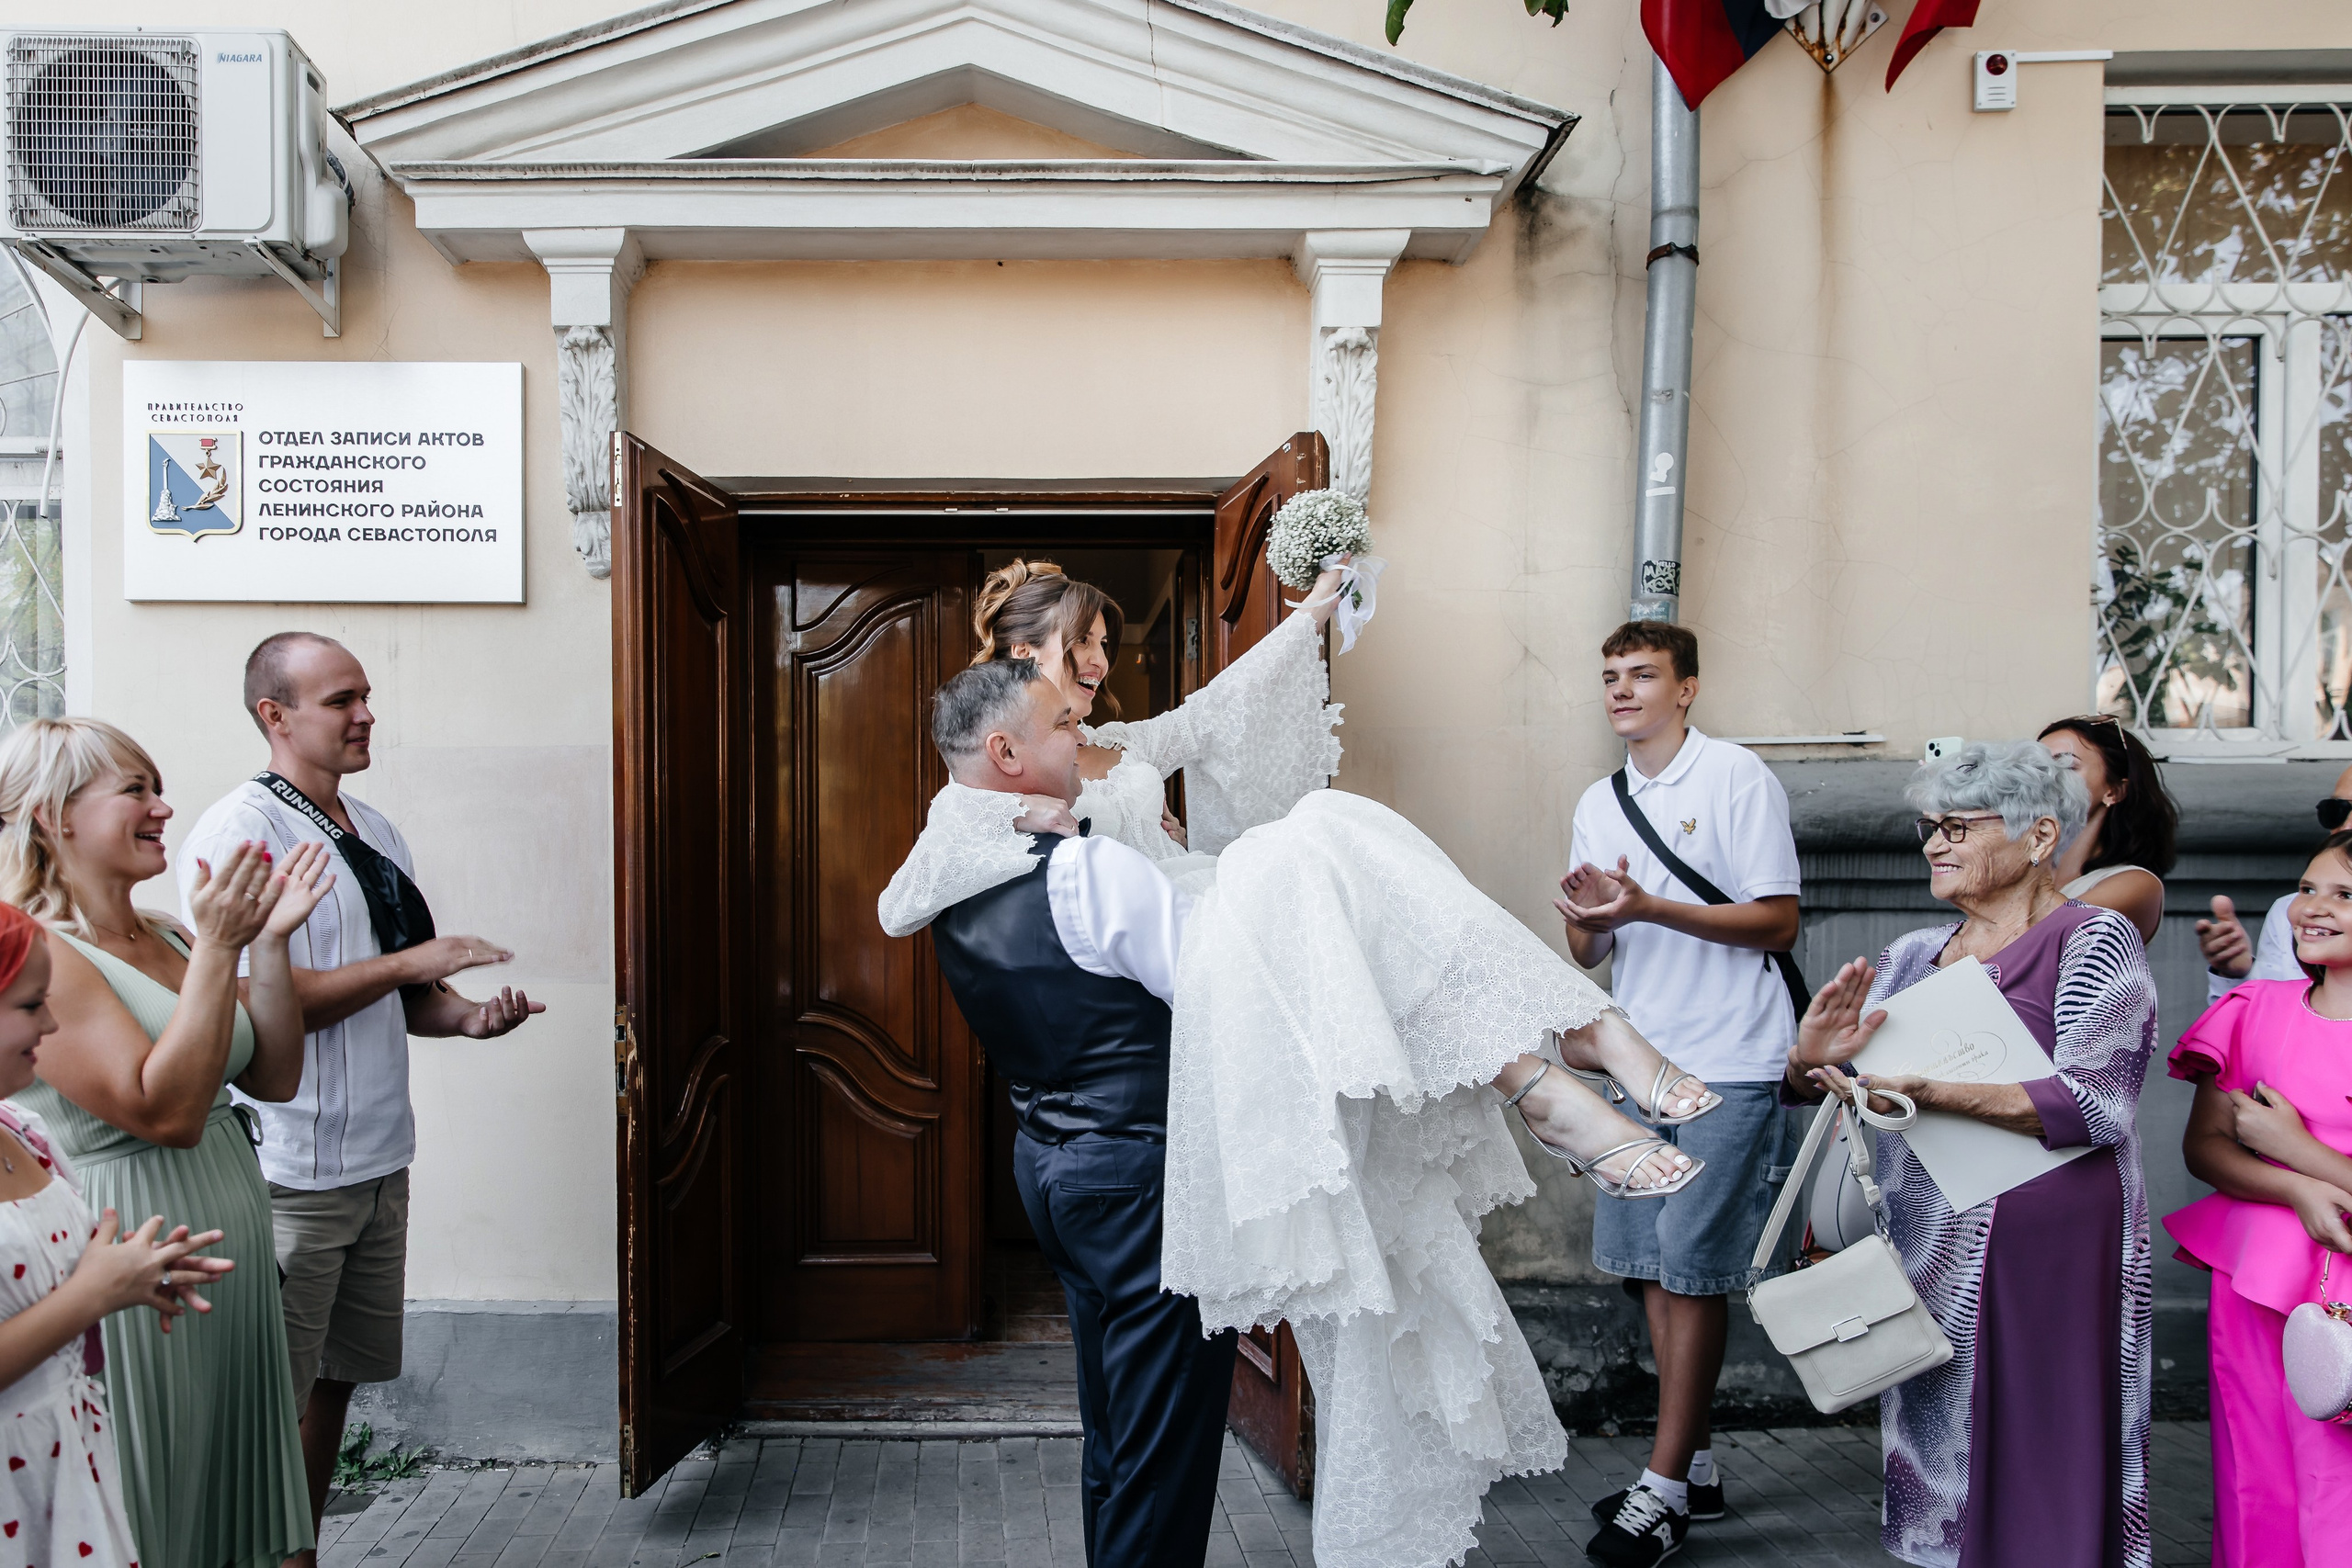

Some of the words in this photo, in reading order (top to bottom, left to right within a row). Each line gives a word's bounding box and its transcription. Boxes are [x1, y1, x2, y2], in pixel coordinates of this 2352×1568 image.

[218, 52, 263, 63] NIAGARA
[147, 402, 243, 412] ПРАВИТЕЛЬСТВО
[151, 413, 238, 423] СЕВАСТОПОЛЯ
[258, 431, 324, 446] ОТДЕЛ
[330, 431, 411, 446] ЗАПИСИ
[417, 432, 485, 446] АКТОВ
[258, 455, 426, 470] ГРАЖДАНСКОГО
[258, 479, 384, 493] СОСТОЯНИЯ
[258, 502, 395, 517] ЛЕНИНСКОГО
[401, 500, 484, 518] РАЙОНА
[258, 526, 341, 543] ГОРОДА
[348, 527, 497, 543] СЕВАСТОПОЛЯ
[270, 780, 344, 840] RUNNING
